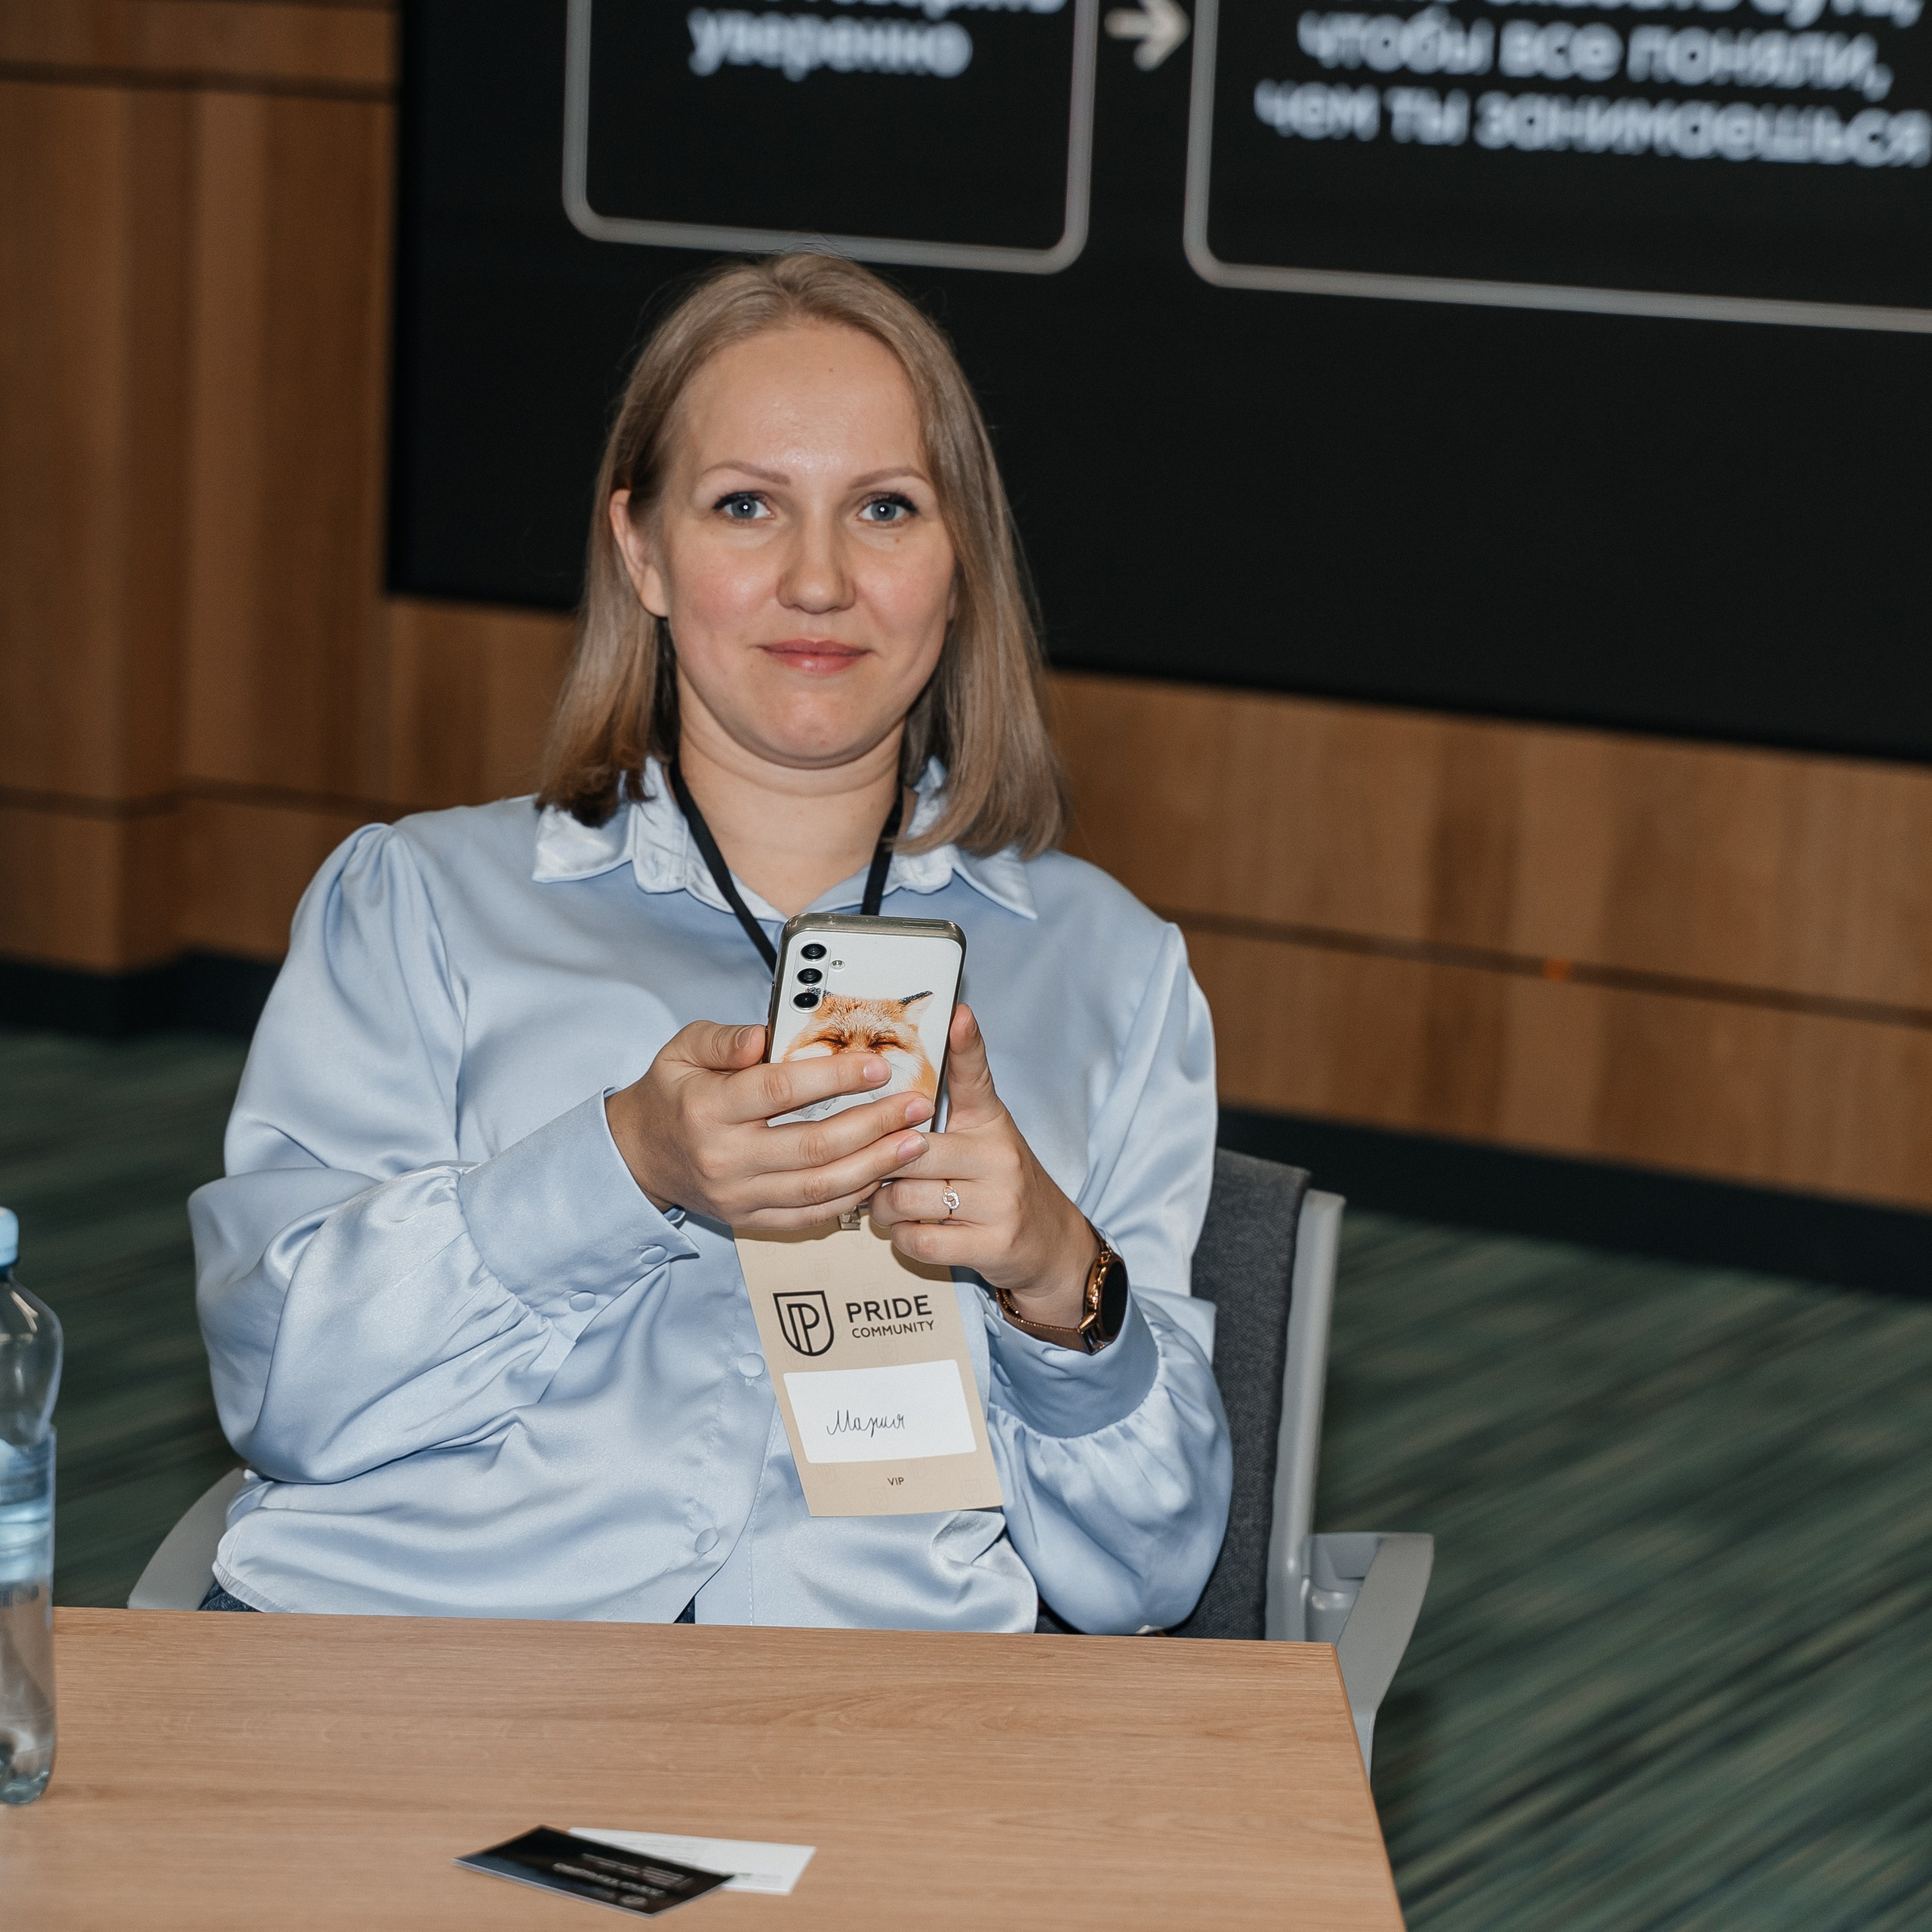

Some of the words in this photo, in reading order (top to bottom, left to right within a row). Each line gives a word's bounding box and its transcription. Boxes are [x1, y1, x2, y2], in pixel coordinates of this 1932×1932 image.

[1297, 6, 1494, 74] чтобы
[1499, 20, 1623, 81] все
[1627, 25, 1893, 100] поняли,
[1254, 81, 1380, 140] чем
[1383, 87, 1469, 146] ты
[845, 1294, 933, 1323] PRIDE
[851, 1319, 934, 1339] COMMUNITY
[826, 1409, 906, 1438] Мария
[887, 1476, 905, 1486] VIP
